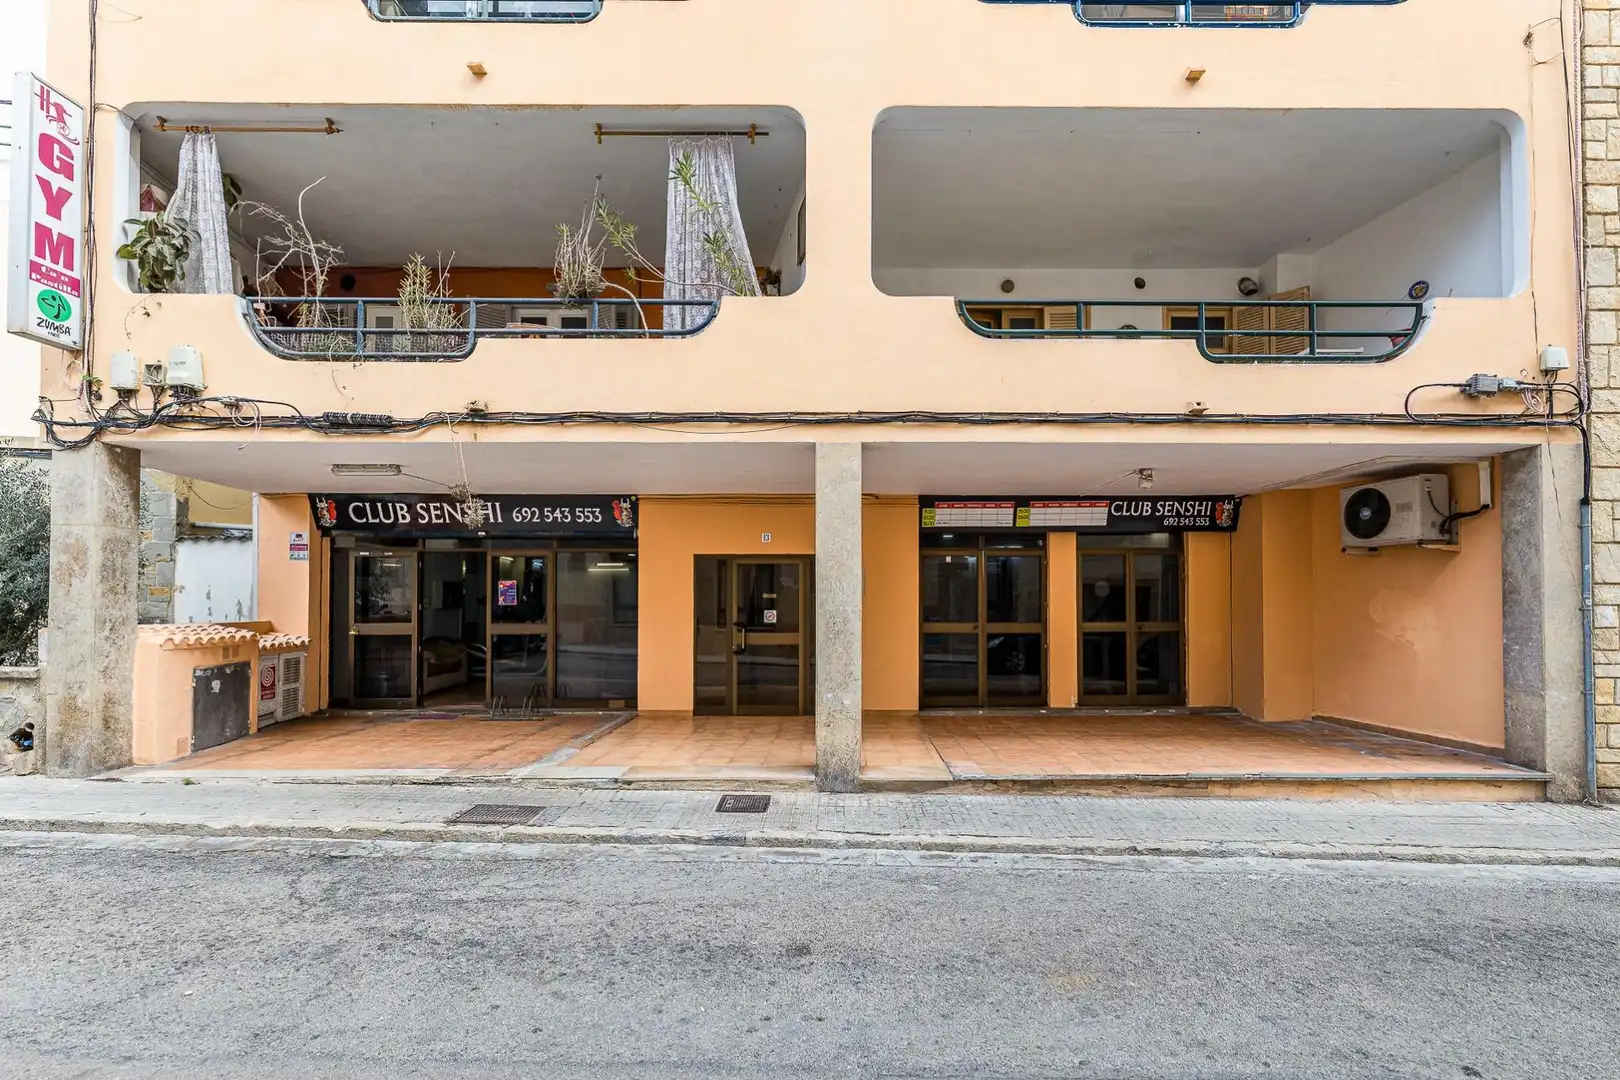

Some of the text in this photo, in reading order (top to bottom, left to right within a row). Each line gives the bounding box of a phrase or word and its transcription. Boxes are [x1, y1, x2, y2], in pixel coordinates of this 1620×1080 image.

[35, 133, 75, 272] GYM
[36, 316, 71, 337] ZUMBA
[348, 502, 602, 524] CLUB SENHI 692 543 553
[1111, 501, 1212, 516] CLUB SENSHI
[1163, 517, 1210, 526] 692 543 553
[763, 533, 770, 542] 13
